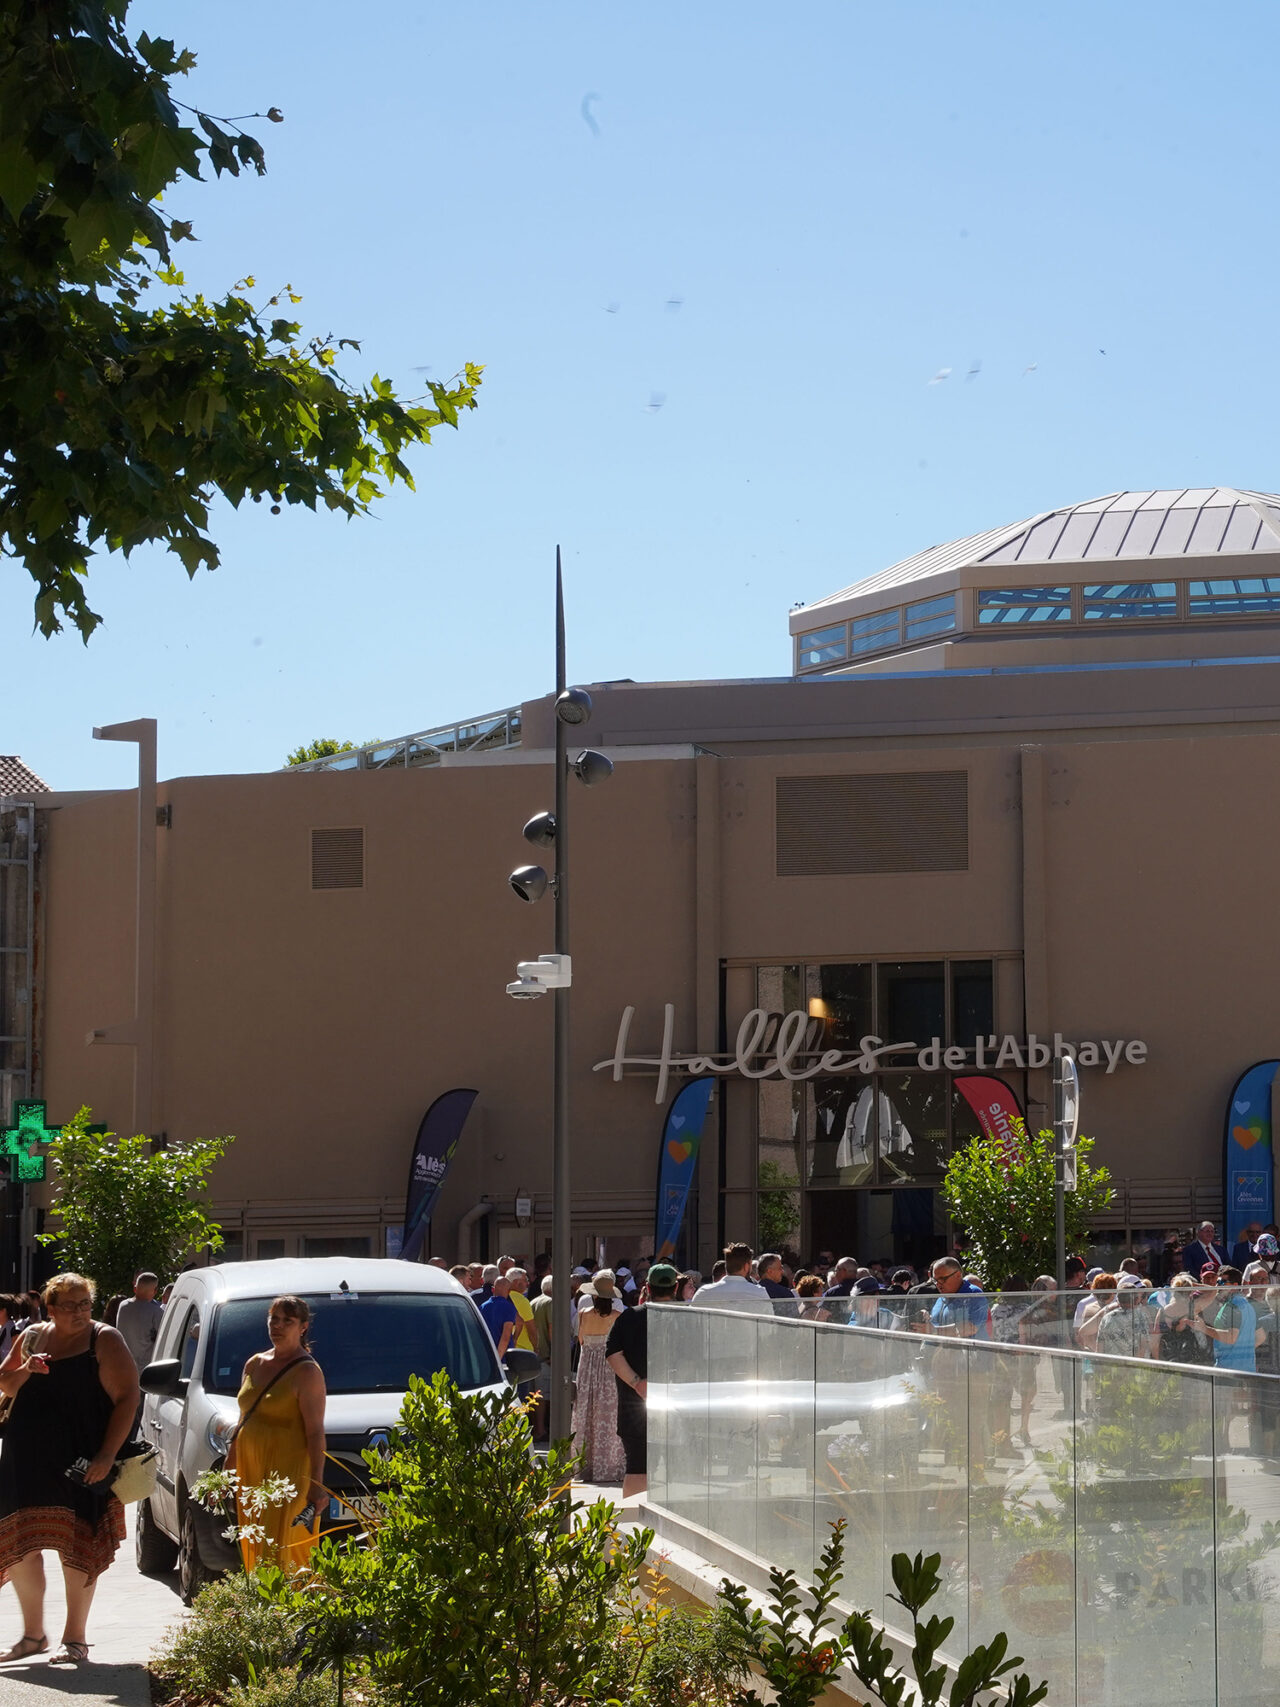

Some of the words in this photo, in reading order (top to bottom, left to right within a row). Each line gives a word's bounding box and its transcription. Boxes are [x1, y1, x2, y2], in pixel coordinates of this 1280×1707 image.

[592, 1003, 917, 1105] Halles
[917, 1036, 967, 1072] de
[975, 1032, 1148, 1074] l'Abbaye
[416, 1152, 446, 1174] Alès
